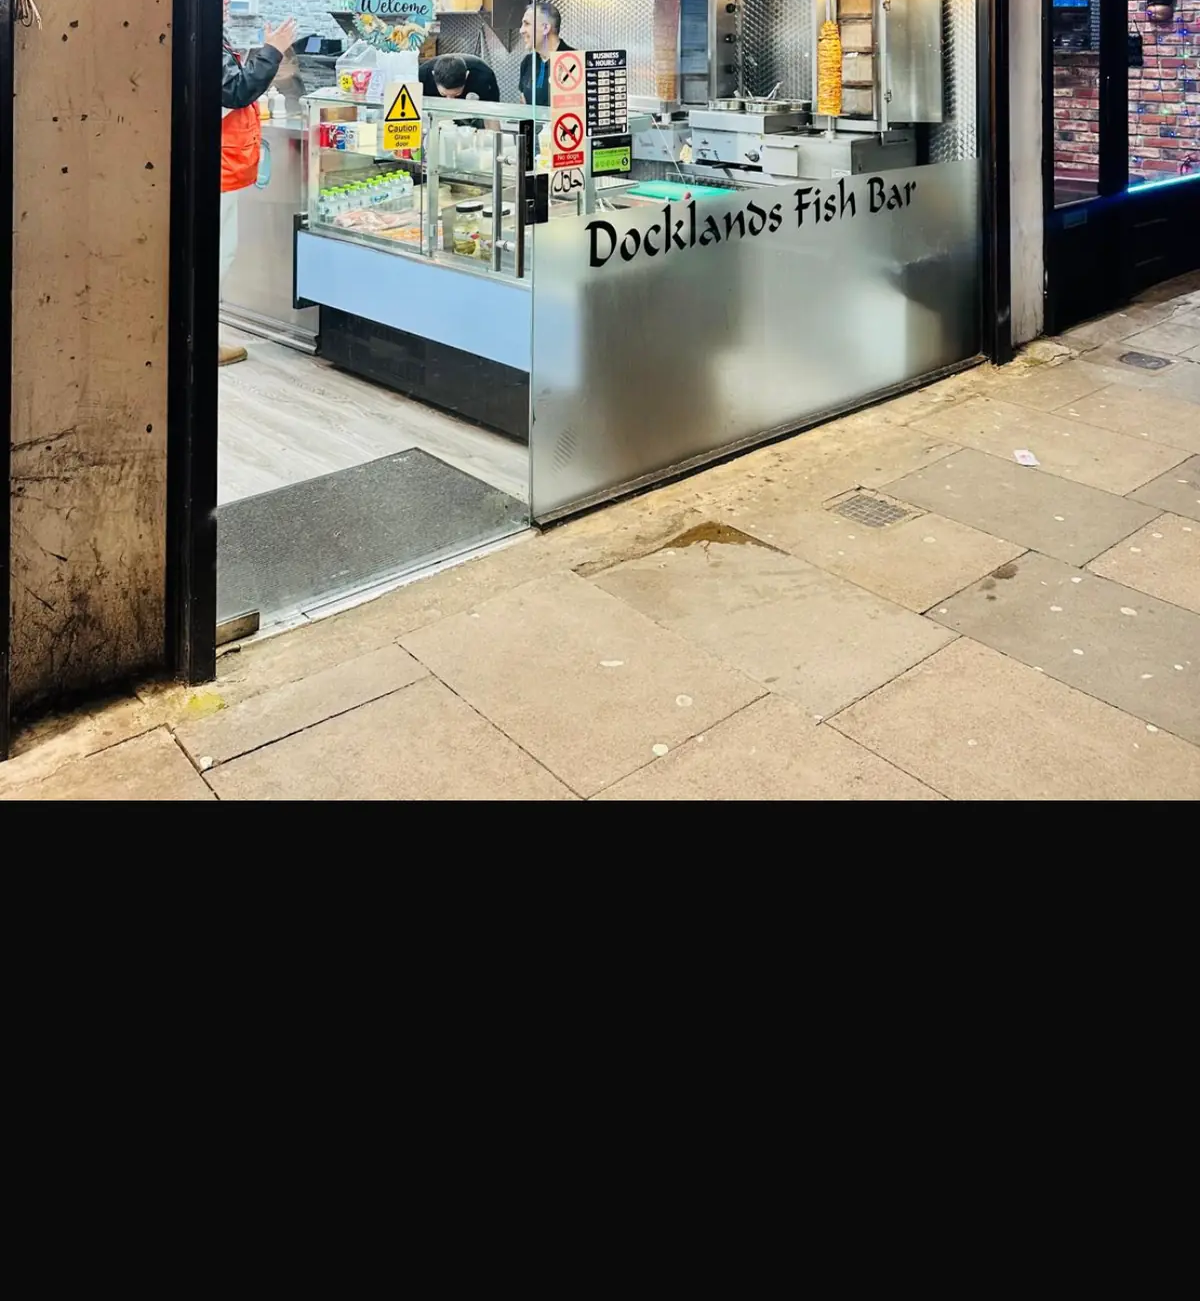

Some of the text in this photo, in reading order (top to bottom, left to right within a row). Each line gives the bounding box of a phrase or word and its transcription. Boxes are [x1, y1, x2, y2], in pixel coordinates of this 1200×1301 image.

[387, 124, 418, 133] Caution
[554, 170, 583, 192] حلال
[584, 176, 917, 268] Docklands Fish Bar
